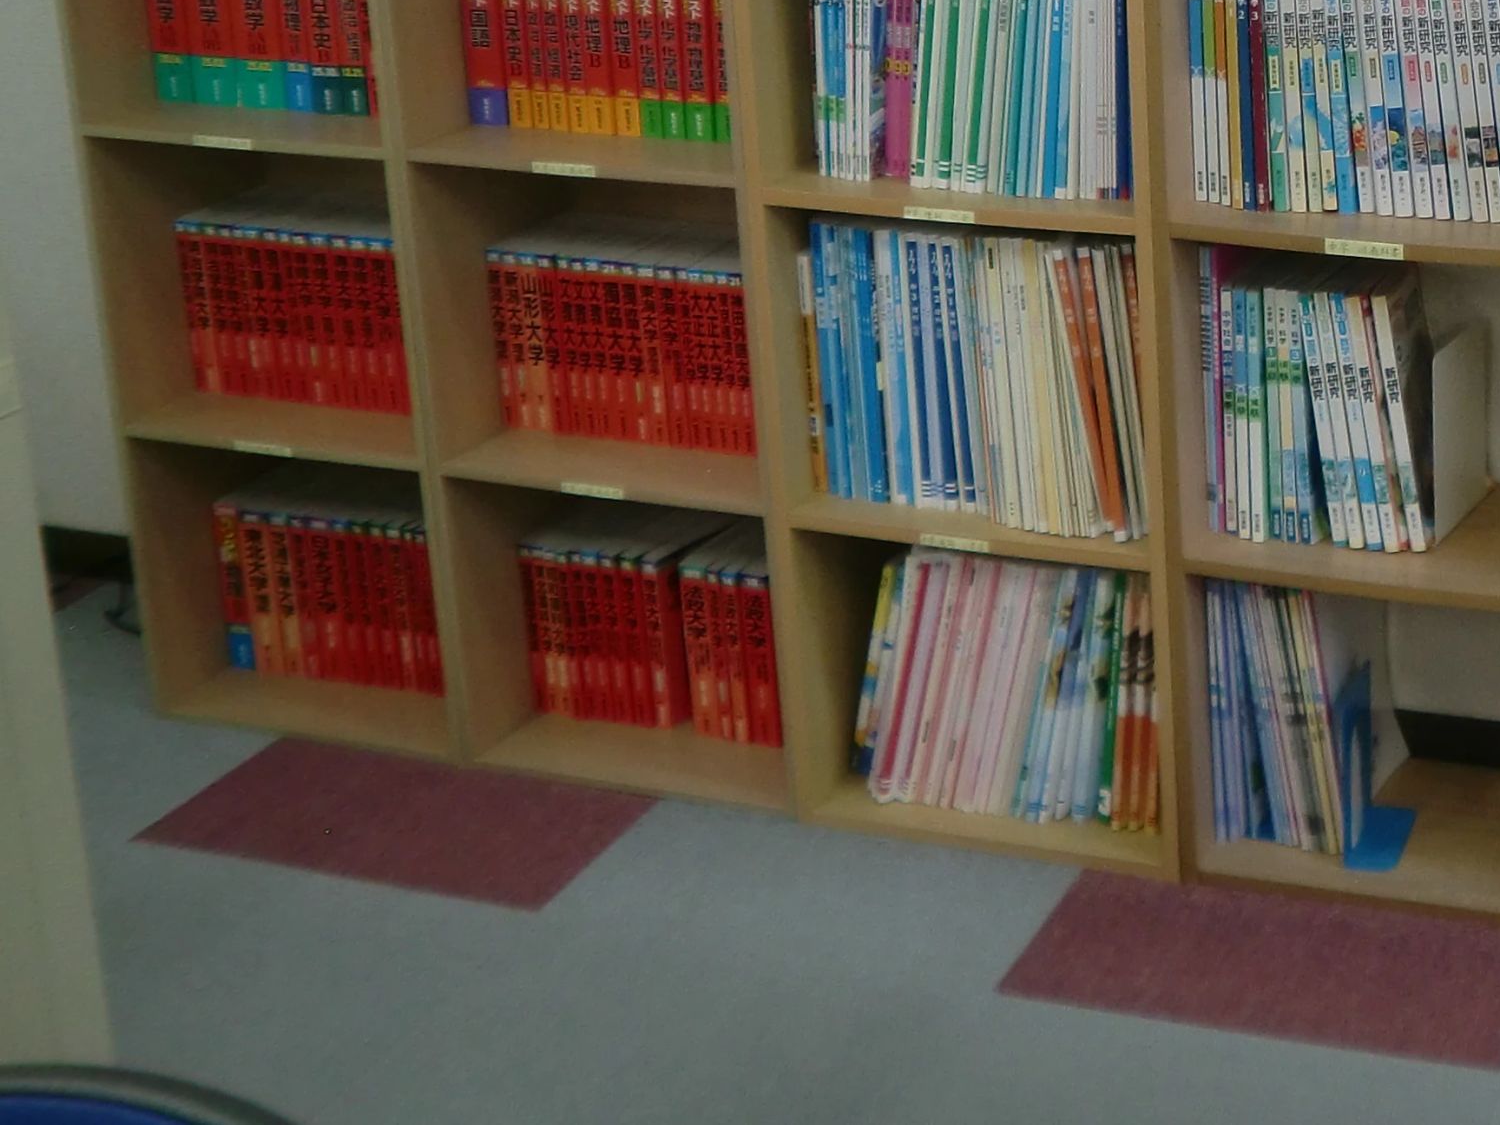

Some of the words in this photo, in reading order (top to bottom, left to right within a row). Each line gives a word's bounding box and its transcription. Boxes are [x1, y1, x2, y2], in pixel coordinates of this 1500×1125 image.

[1283, 11, 1297, 49] 新研究
[1312, 9, 1326, 46] 新研究
[1358, 366, 1374, 403] 新研究
[1384, 367, 1400, 404] 新研究
